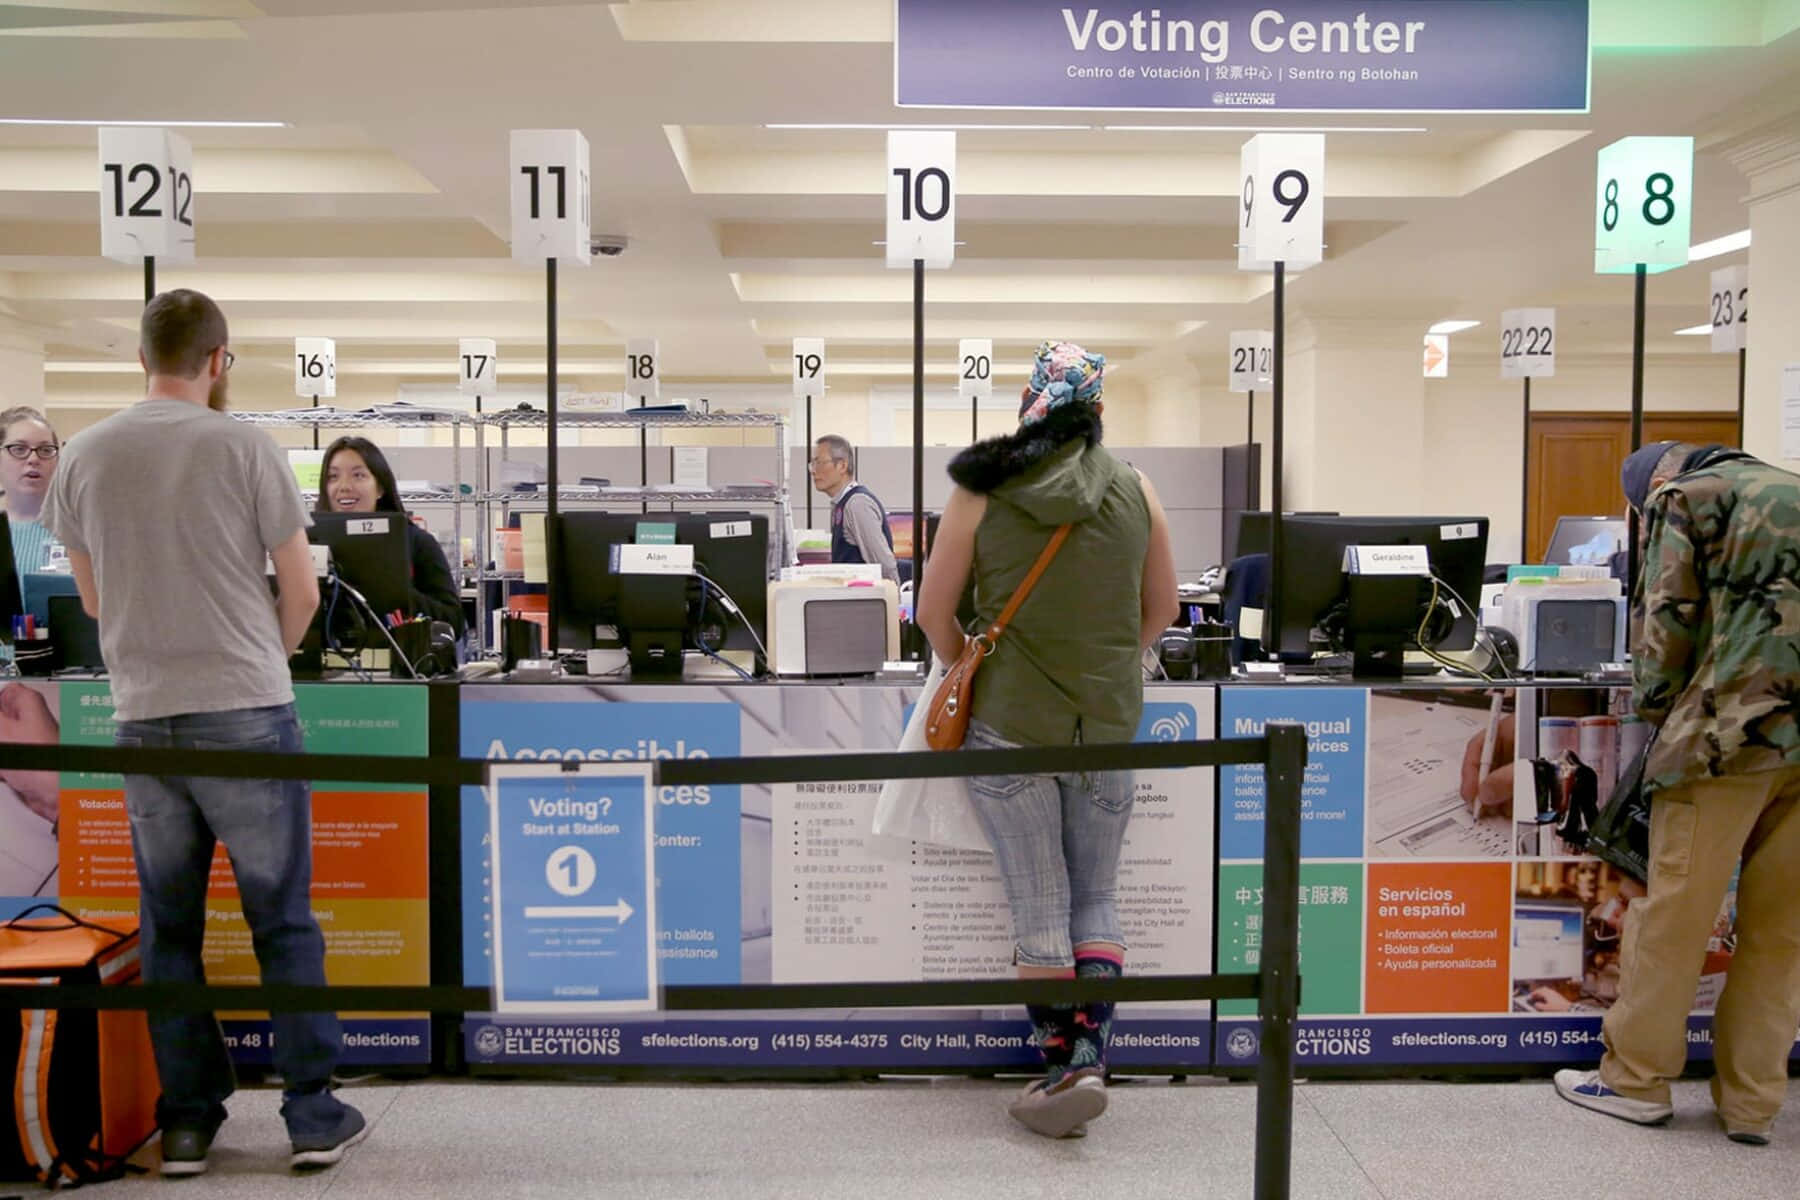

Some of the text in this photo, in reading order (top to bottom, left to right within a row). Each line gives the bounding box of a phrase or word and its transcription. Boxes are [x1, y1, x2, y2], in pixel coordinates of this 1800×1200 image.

[1062, 9, 1425, 63] Voting Center
[1067, 65, 1200, 78] Centro de Votación
[1216, 65, 1273, 80] 投票中心
[1288, 67, 1418, 82] Sentro ng Botohan
[105, 163, 162, 217] 12
[168, 166, 193, 227] 12
[521, 166, 566, 219] 11
[893, 167, 950, 221] 10
[1273, 169, 1310, 222] 9
[1243, 175, 1255, 228] 9
[1602, 178, 1619, 231] 8
[1642, 172, 1675, 226] 8
[1712, 290, 1734, 327] 23
[1738, 287, 1748, 323] 2
[1502, 329, 1522, 357] 22
[1526, 326, 1552, 355] 22
[297, 354, 324, 378] 16
[463, 354, 488, 379] 17
[628, 355, 654, 379] 18
[795, 354, 822, 379] 19
[963, 356, 990, 380] 20
[1234, 347, 1255, 372] 21
[1260, 347, 1272, 373] 21
[362, 521, 374, 532] 12
[646, 552, 667, 561] Alan
[1372, 553, 1414, 562] Geraldine
[1307, 739, 1349, 752] vices
[1235, 774, 1329, 784] inform fficial
[79, 800, 124, 809] Votación
[1135, 793, 1168, 803] agboto
[528, 797, 612, 821] Voting?
[1235, 811, 1264, 820] assist
[1301, 811, 1313, 819] nd
[522, 822, 620, 836] Start at Station
[558, 853, 578, 887] 1
[1235, 886, 1348, 905] 中文言服務
[1379, 887, 1453, 901] Servicios
[1378, 902, 1465, 919] en español
[674, 929, 714, 941] ballots
[1385, 928, 1497, 940] Información electoral
[1384, 943, 1454, 955] Boleta oficial
[1384, 958, 1497, 971] Ayuda personalizada
[242, 1034, 261, 1047] 48
[343, 1033, 420, 1047] felections
[505, 1027, 621, 1037] SAN FRANCISCO
[1298, 1028, 1371, 1038] RANCISCO
[1392, 1029, 1713, 1048] sfelections.org (415) 554-4 all,
[505, 1038, 621, 1055] ELECTIONS
[642, 1034, 759, 1050] sfelections.org
[772, 1034, 810, 1050] (415)
[815, 1034, 887, 1048] 554-4375
[900, 1034, 931, 1050] City
[936, 1034, 970, 1049] Hall,
[975, 1034, 1022, 1047] Room
[1109, 1033, 1200, 1048] /sfelections
[1296, 1038, 1371, 1055] CTIONS
